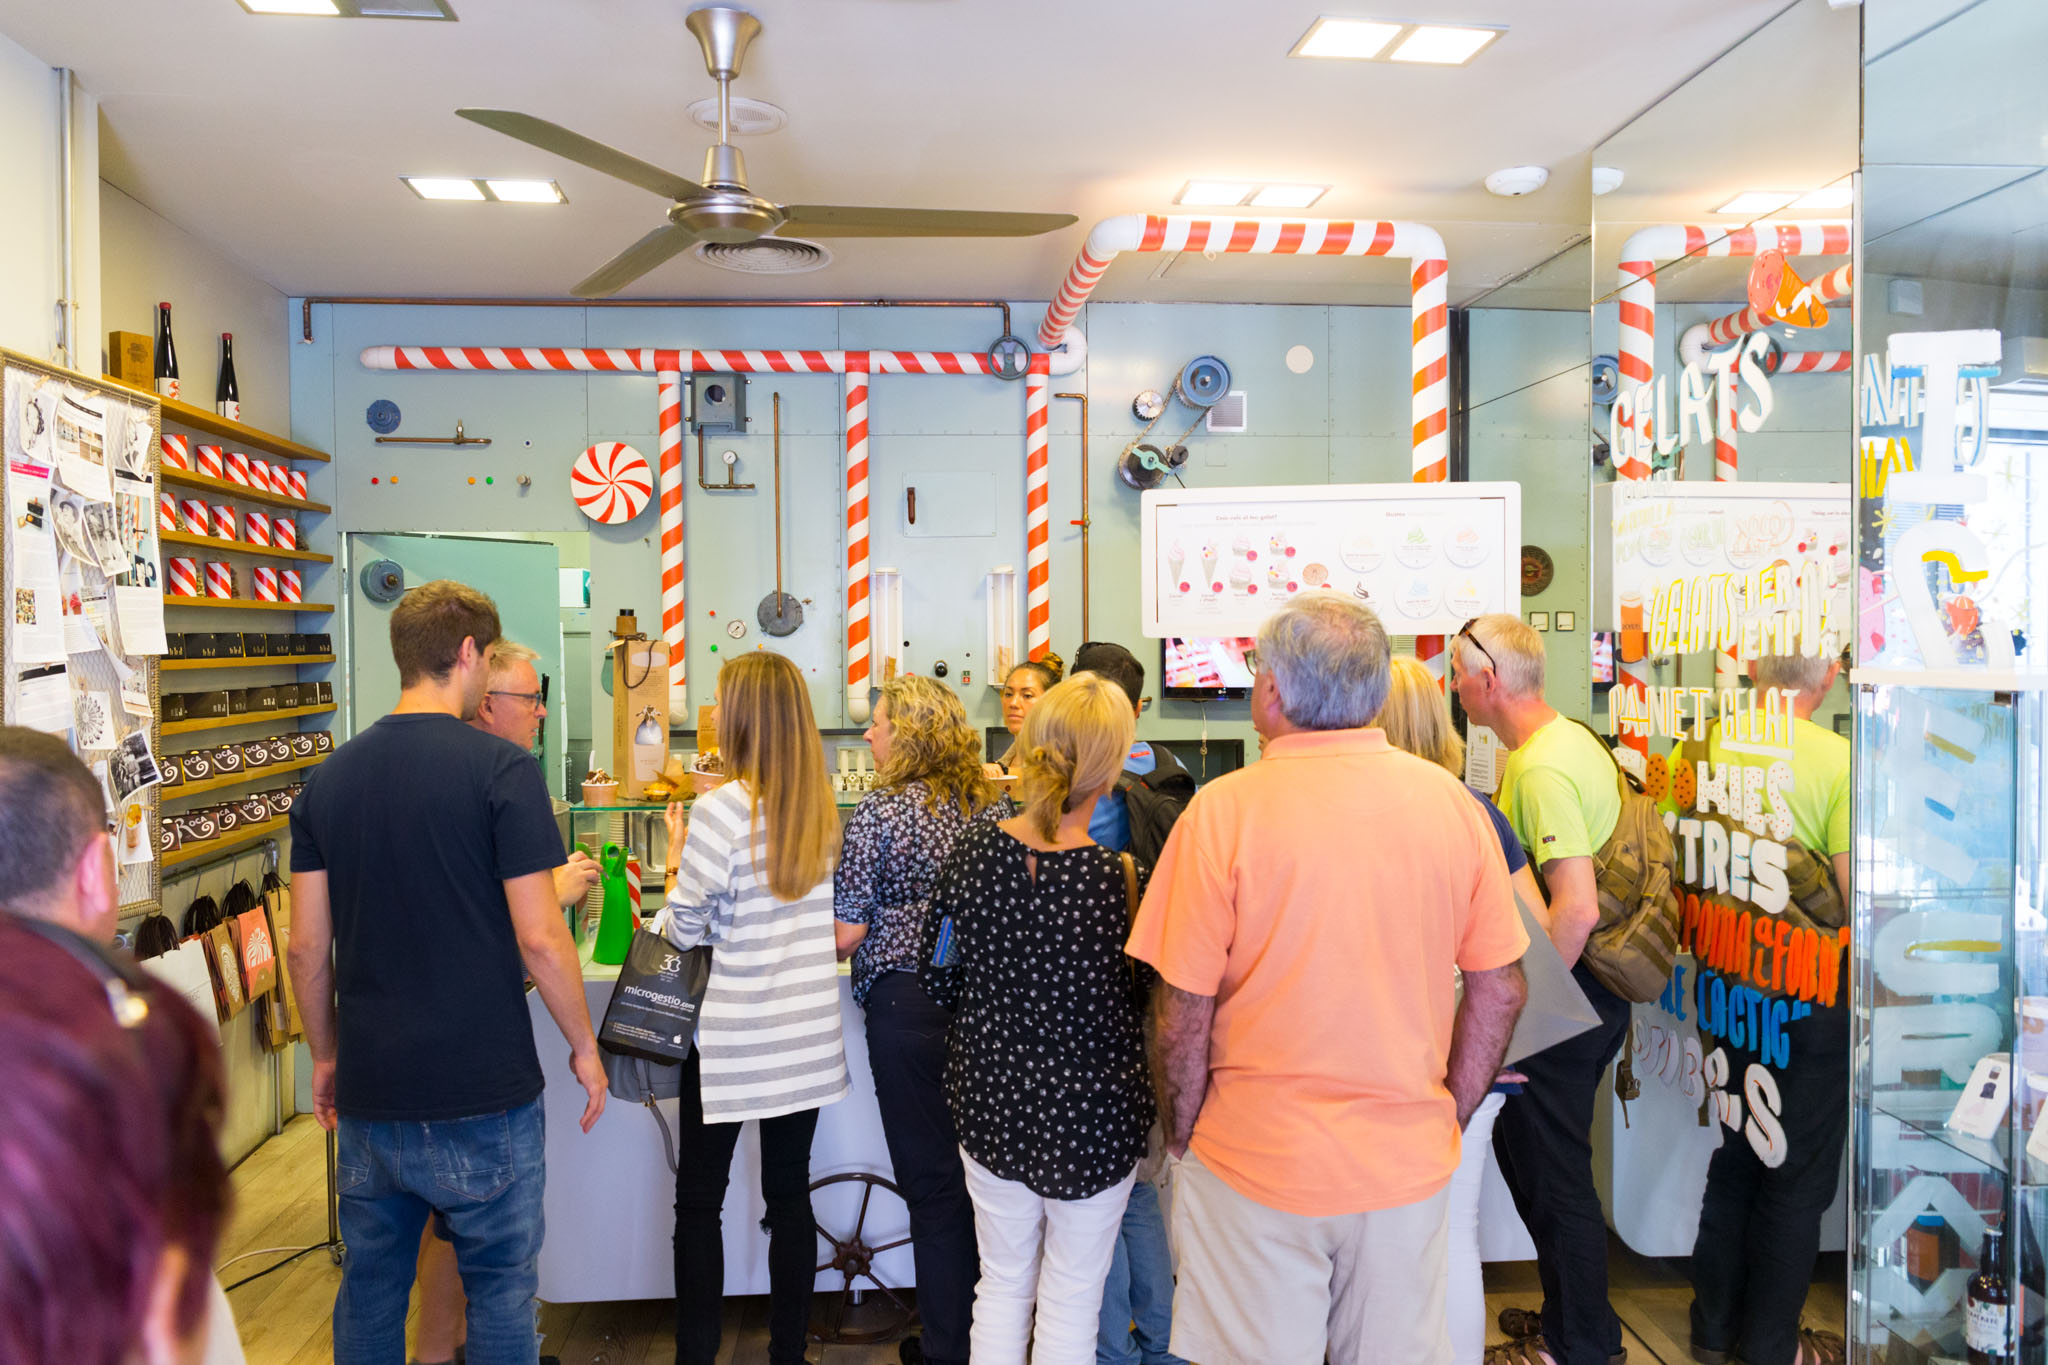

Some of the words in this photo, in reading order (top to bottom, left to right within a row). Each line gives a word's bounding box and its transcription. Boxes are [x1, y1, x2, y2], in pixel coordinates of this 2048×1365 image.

[1610, 332, 1774, 467] GELATS
[1649, 572, 1739, 656] GELATS
[1608, 684, 1714, 742] PANET
[1719, 686, 1801, 747] GELAT
[1664, 811, 1790, 914] TRES
[624, 985, 696, 1010] microgestio.com
